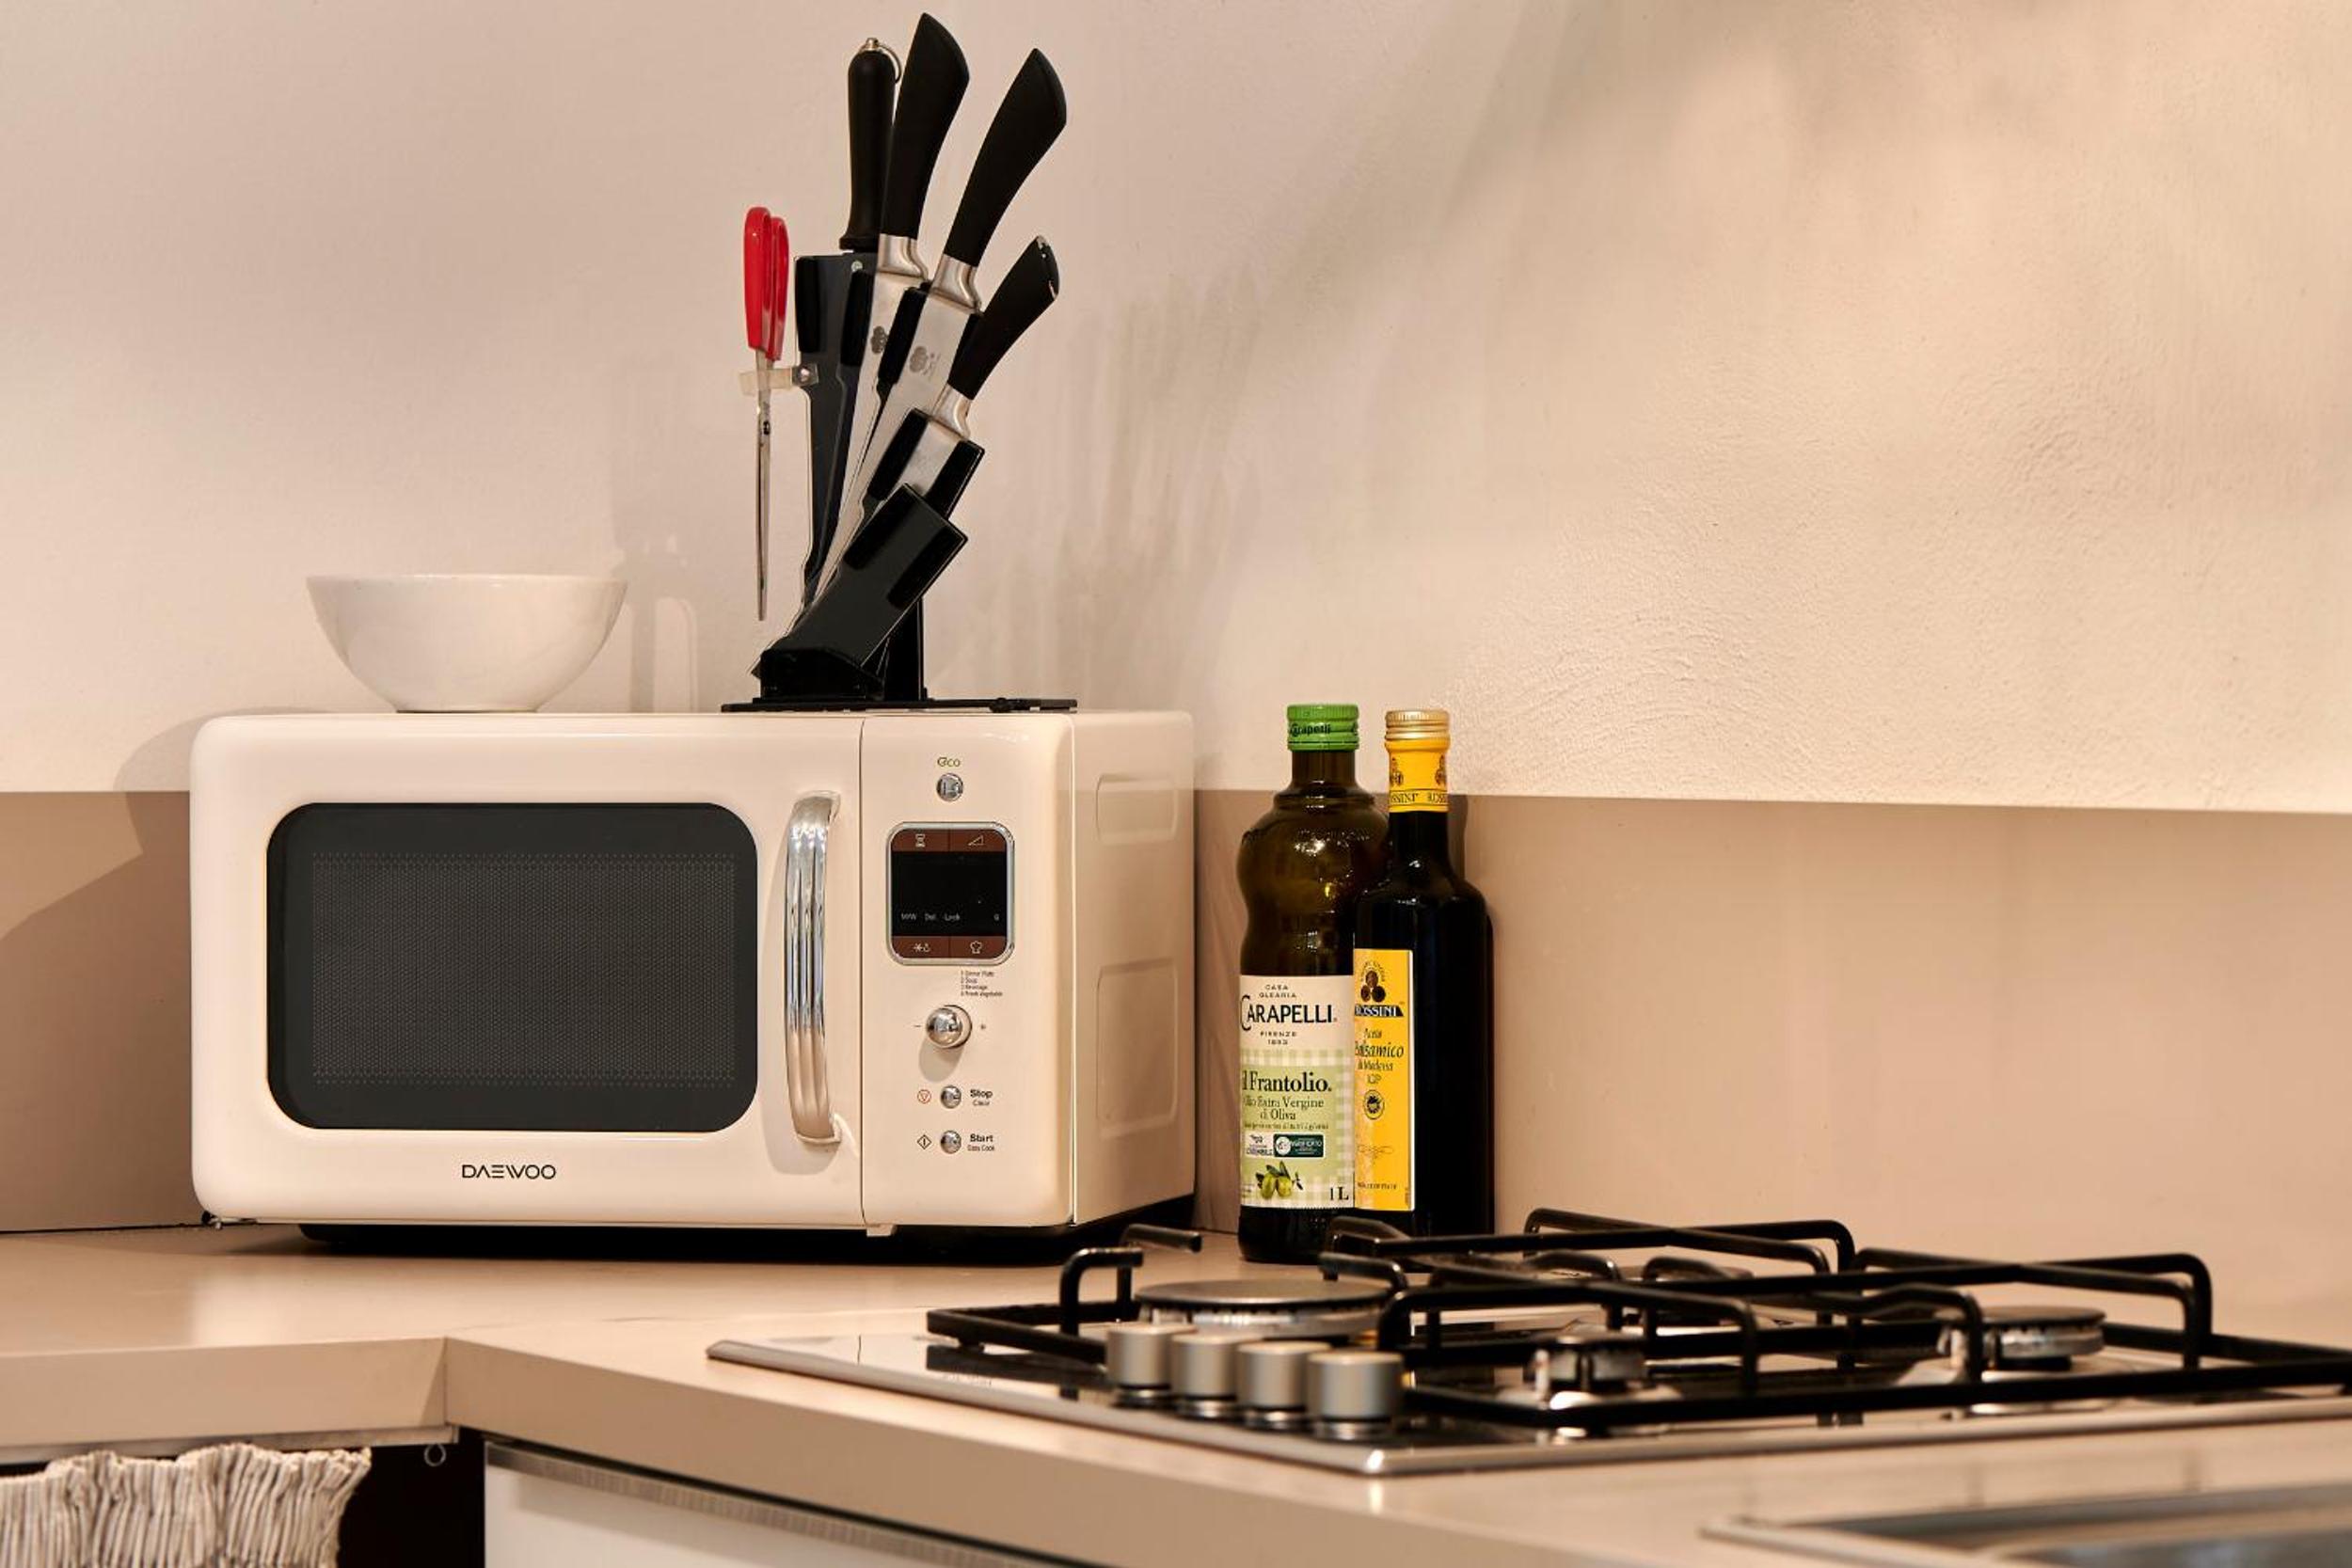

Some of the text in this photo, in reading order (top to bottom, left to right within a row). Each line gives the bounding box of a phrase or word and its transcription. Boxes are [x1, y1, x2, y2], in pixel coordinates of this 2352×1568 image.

[970, 1089, 993, 1100] Stop
[1282, 1095, 1325, 1111] Vergine
[1270, 1108, 1296, 1120] Oliva
[970, 1133, 993, 1143] Start
[462, 1164, 556, 1180] DAEWOO
[1338, 1187, 1349, 1201] L
